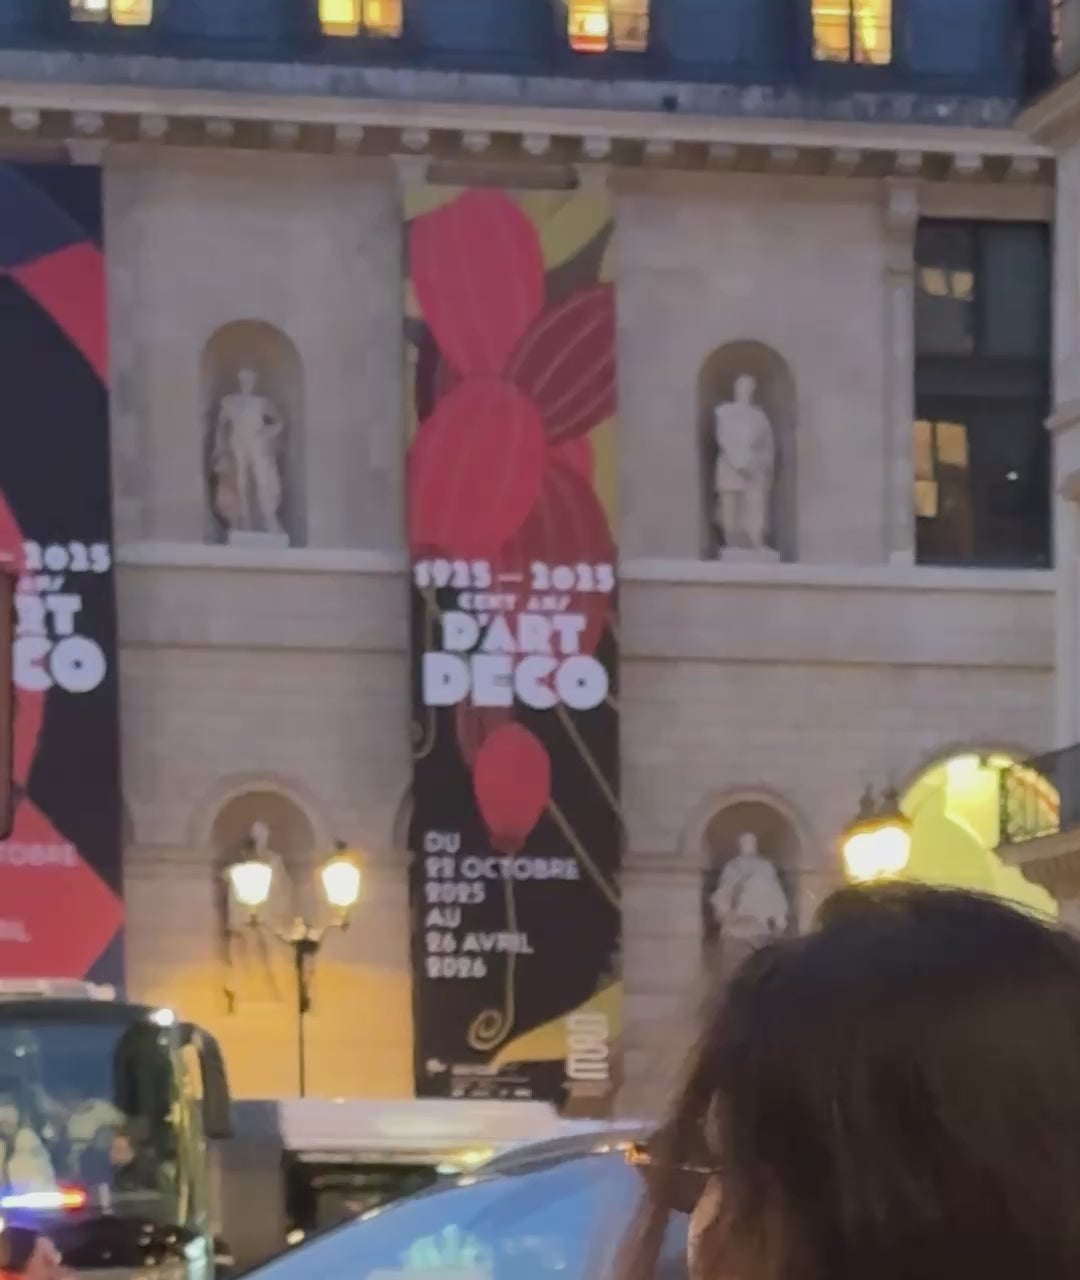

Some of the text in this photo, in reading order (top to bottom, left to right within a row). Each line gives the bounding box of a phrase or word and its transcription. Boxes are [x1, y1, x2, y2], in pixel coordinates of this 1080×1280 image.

[414, 559, 492, 588] 1925
[530, 560, 615, 592] 2025
[442, 610, 586, 655] D'ART
[422, 651, 609, 710] DECO
[424, 830, 461, 853] DU
[461, 856, 580, 880] OCTOBRE
[425, 881, 486, 903] 2025
[425, 906, 461, 928] AU
[462, 932, 534, 953] AVRIL
[425, 956, 487, 978] 2026
